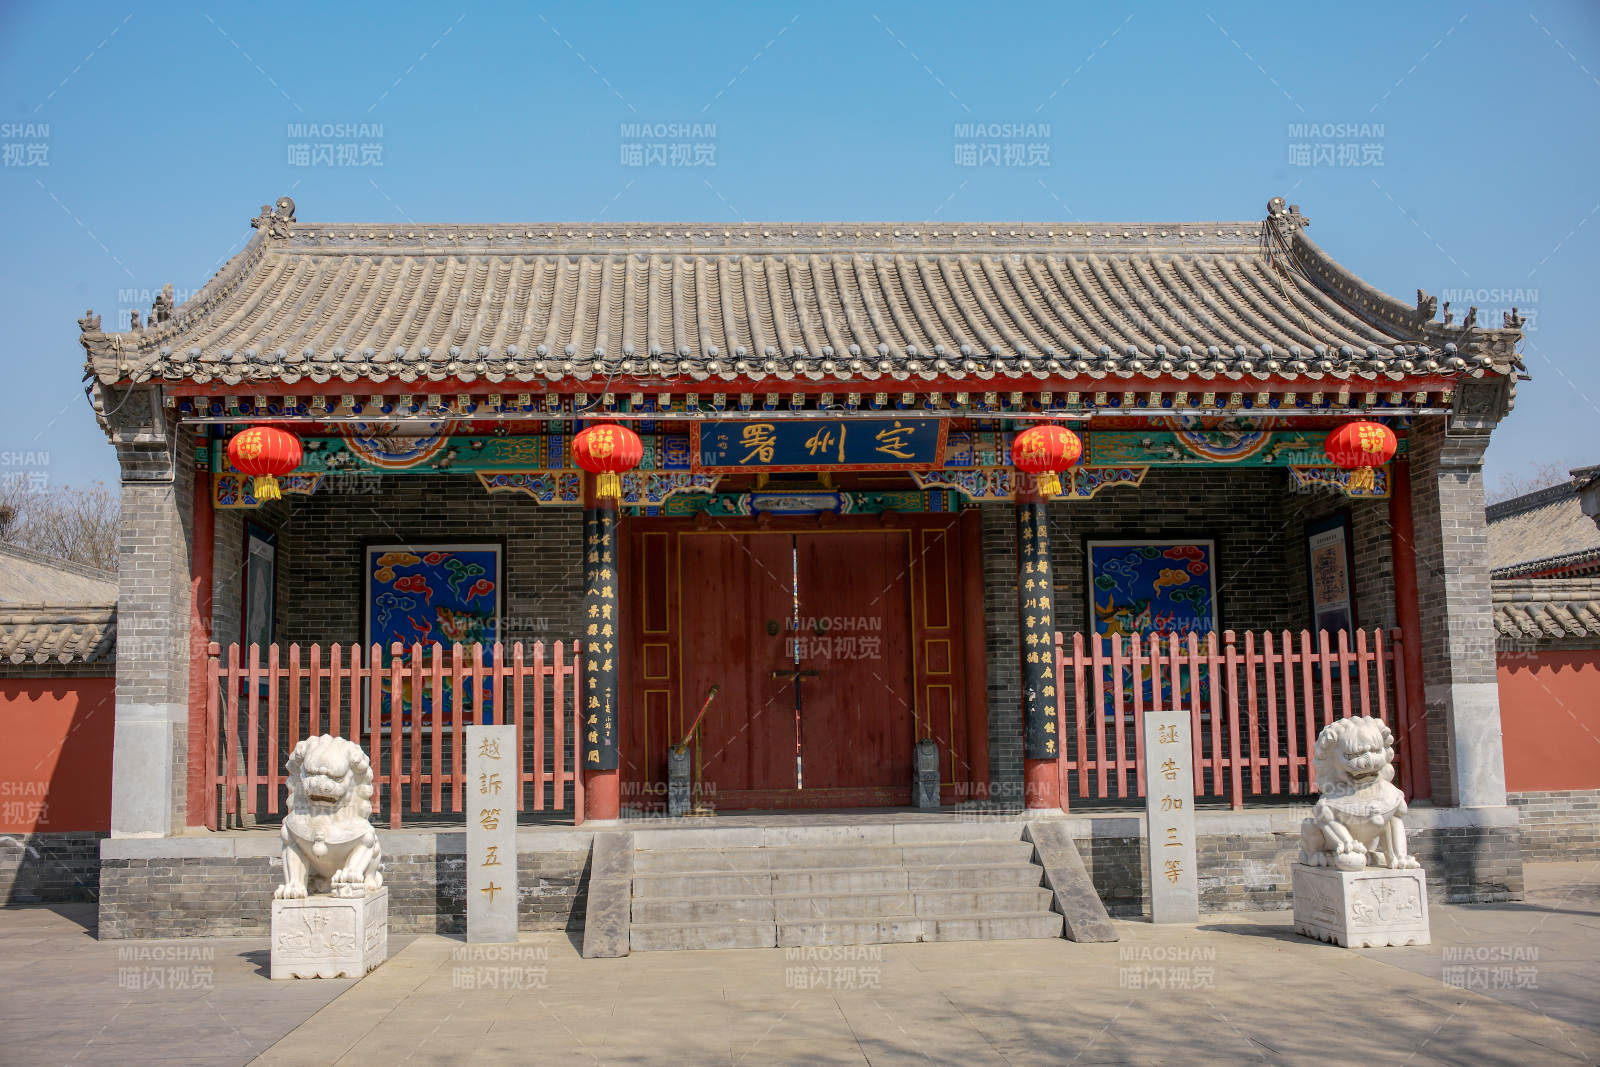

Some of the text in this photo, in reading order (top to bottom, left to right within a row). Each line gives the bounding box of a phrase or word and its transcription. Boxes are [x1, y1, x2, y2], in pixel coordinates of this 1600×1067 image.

[478, 736, 503, 905] 越訴笞五十
[1158, 723, 1184, 885] 誣告加三等
